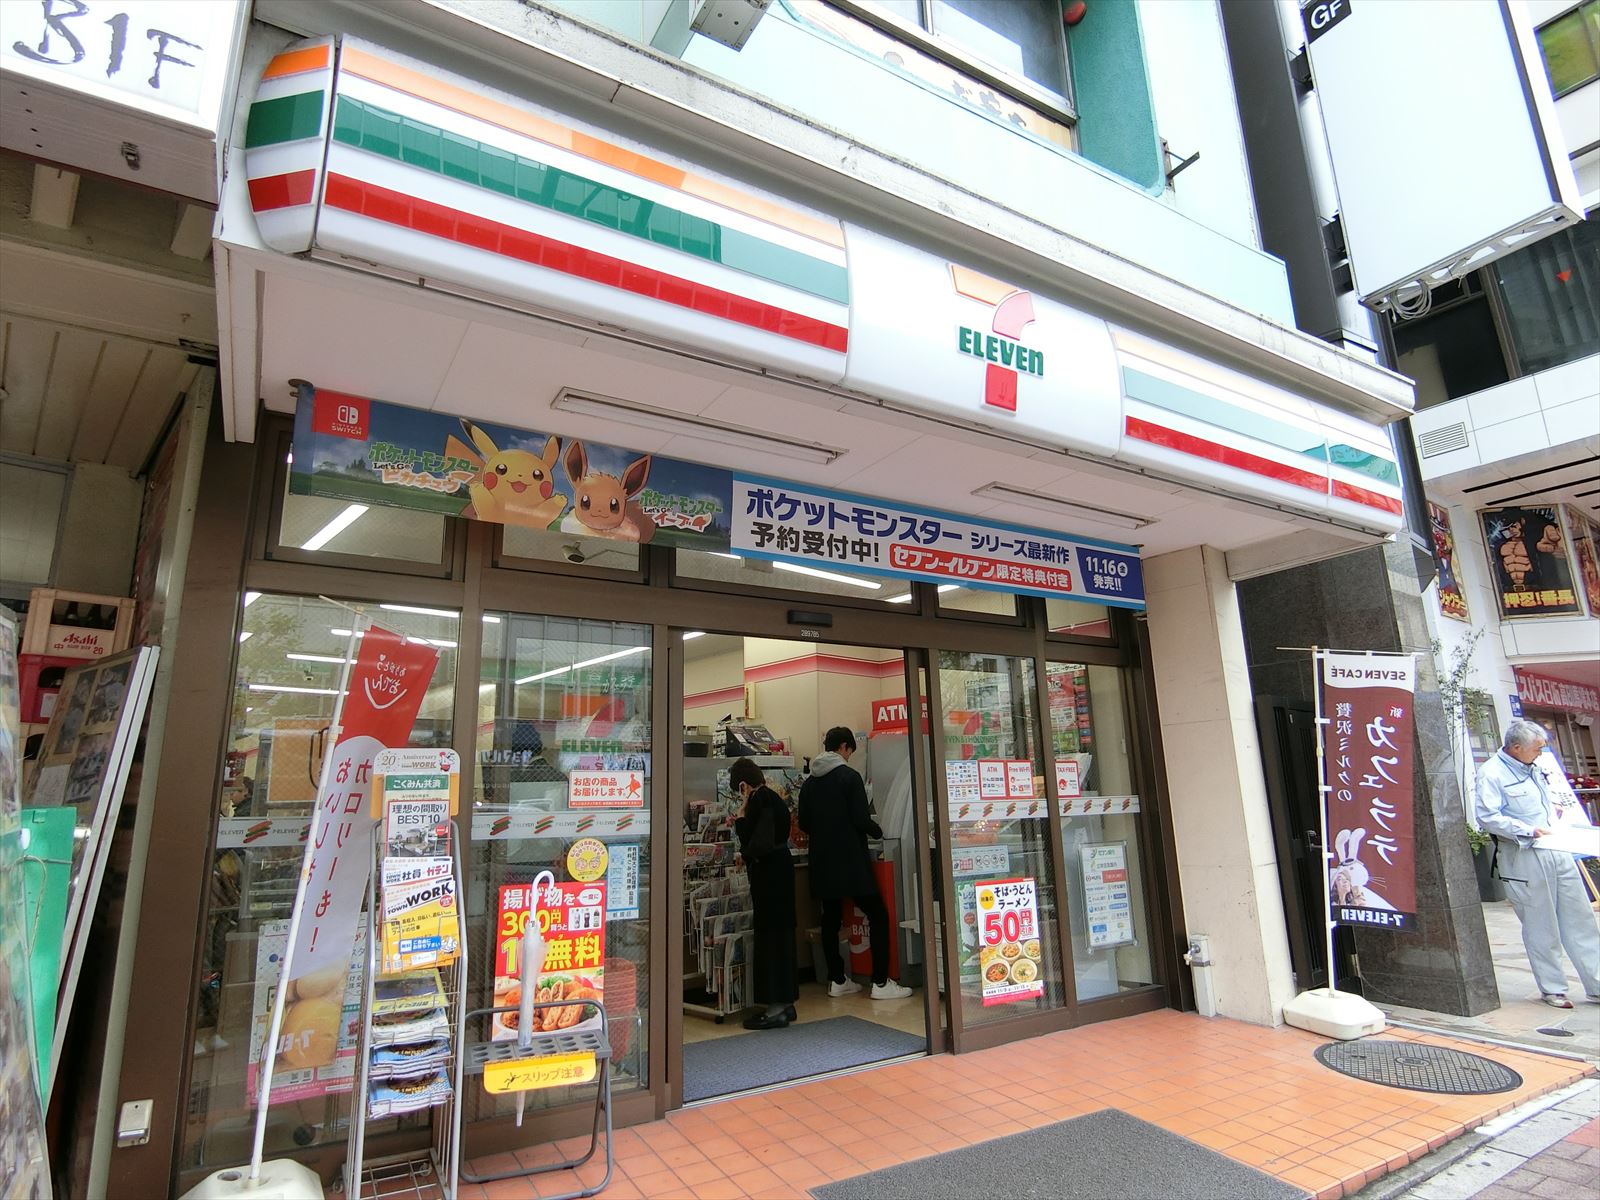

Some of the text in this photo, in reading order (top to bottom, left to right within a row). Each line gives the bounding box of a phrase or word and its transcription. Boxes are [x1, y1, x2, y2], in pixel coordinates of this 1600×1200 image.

[331, 425, 362, 435] SWITCH
[368, 442, 480, 473] ポケットモンスター
[373, 462, 396, 470] Let's
[383, 469, 475, 493] ピカチュウ
[639, 489, 723, 515] ポケットモンスター
[644, 506, 660, 514] Let's
[652, 513, 713, 533] イーブイ
[746, 488, 1070, 565] ポケットモンスター シリーズ最新作
[63, 633, 98, 645] Asahi
[93, 647, 103, 655] 20
[381, 755, 396, 766] 20
[393, 779, 441, 789] こくみん共済
[573, 777, 617, 787] お店の商品
[392, 803, 447, 814] 理想の間取り
[397, 813, 441, 825] BEST 10
[387, 903, 408, 915] TOWN
[406, 882, 453, 907] WORK
[998, 897, 1031, 910] ラーメン
[522, 1065, 585, 1083] スリップ注意
